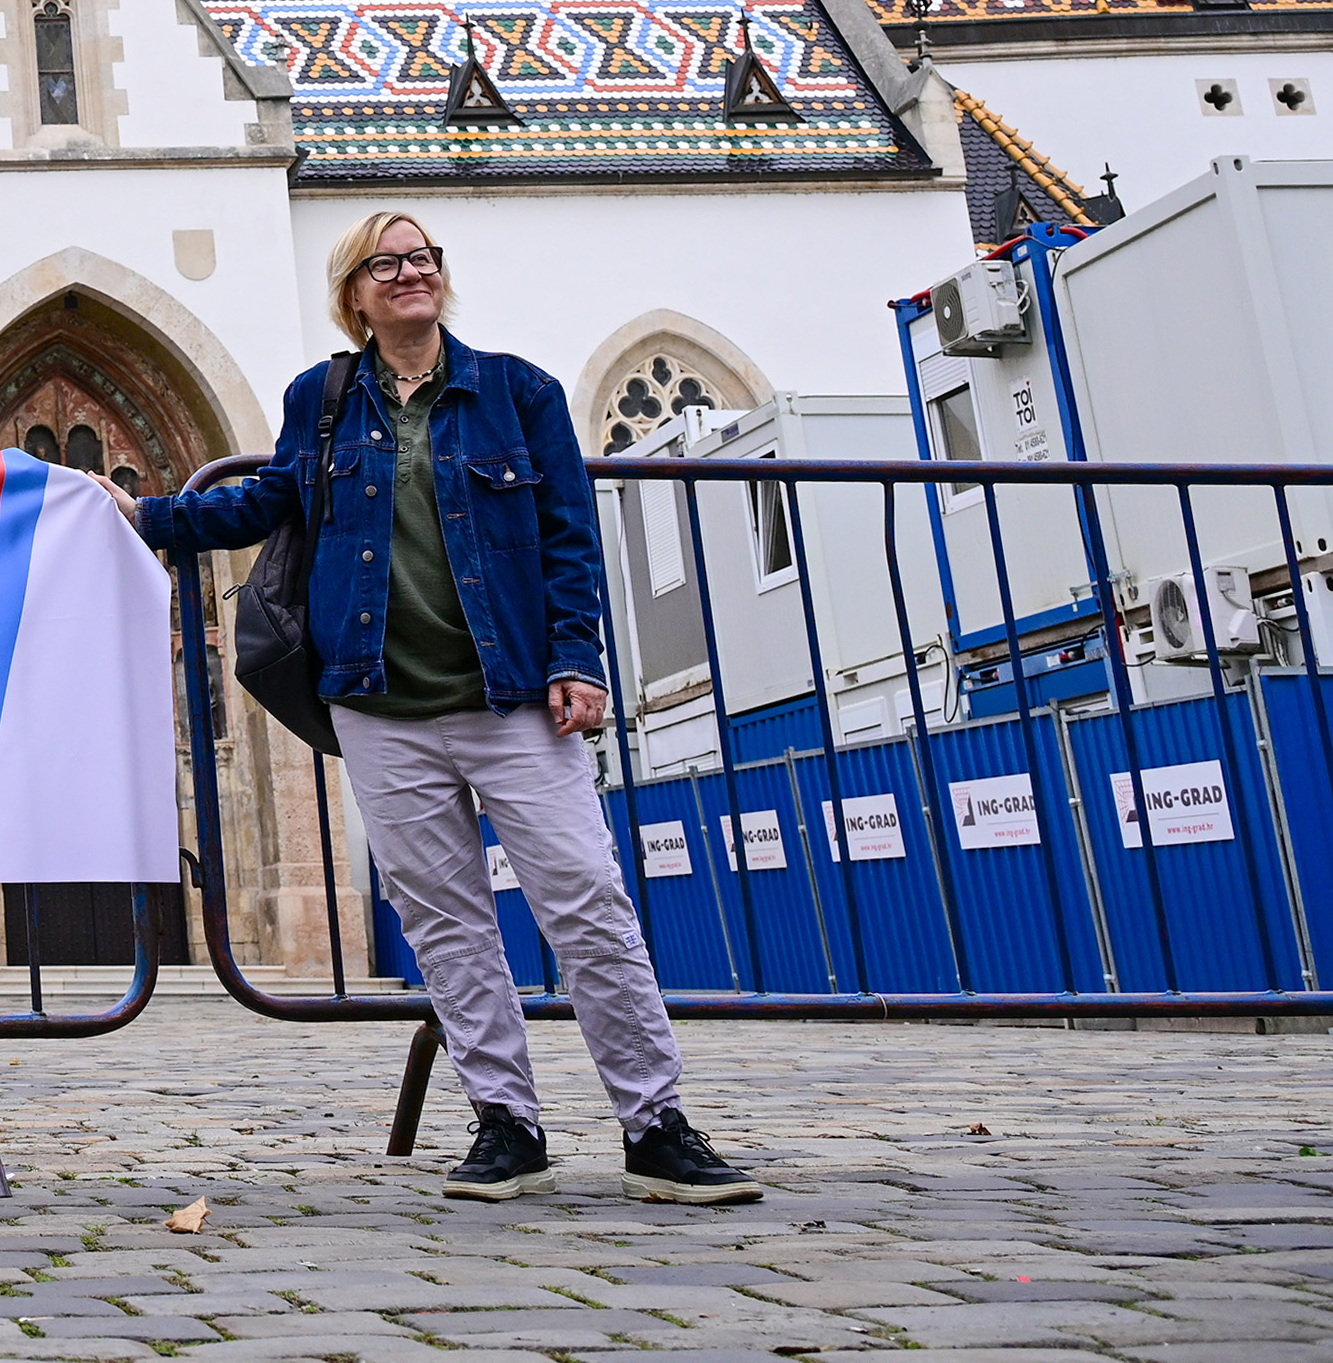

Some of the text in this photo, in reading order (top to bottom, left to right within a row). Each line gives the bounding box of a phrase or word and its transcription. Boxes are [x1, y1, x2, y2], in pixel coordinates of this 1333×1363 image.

[1016, 405, 1036, 426] TOI
[1146, 785, 1223, 810] ING-GRAD
[846, 813, 897, 832] ING-GRAD
[1167, 823, 1213, 834] www.ing-grad.hr
[743, 827, 779, 843] NG-GRAD
[647, 837, 685, 853] ING-GRAD
